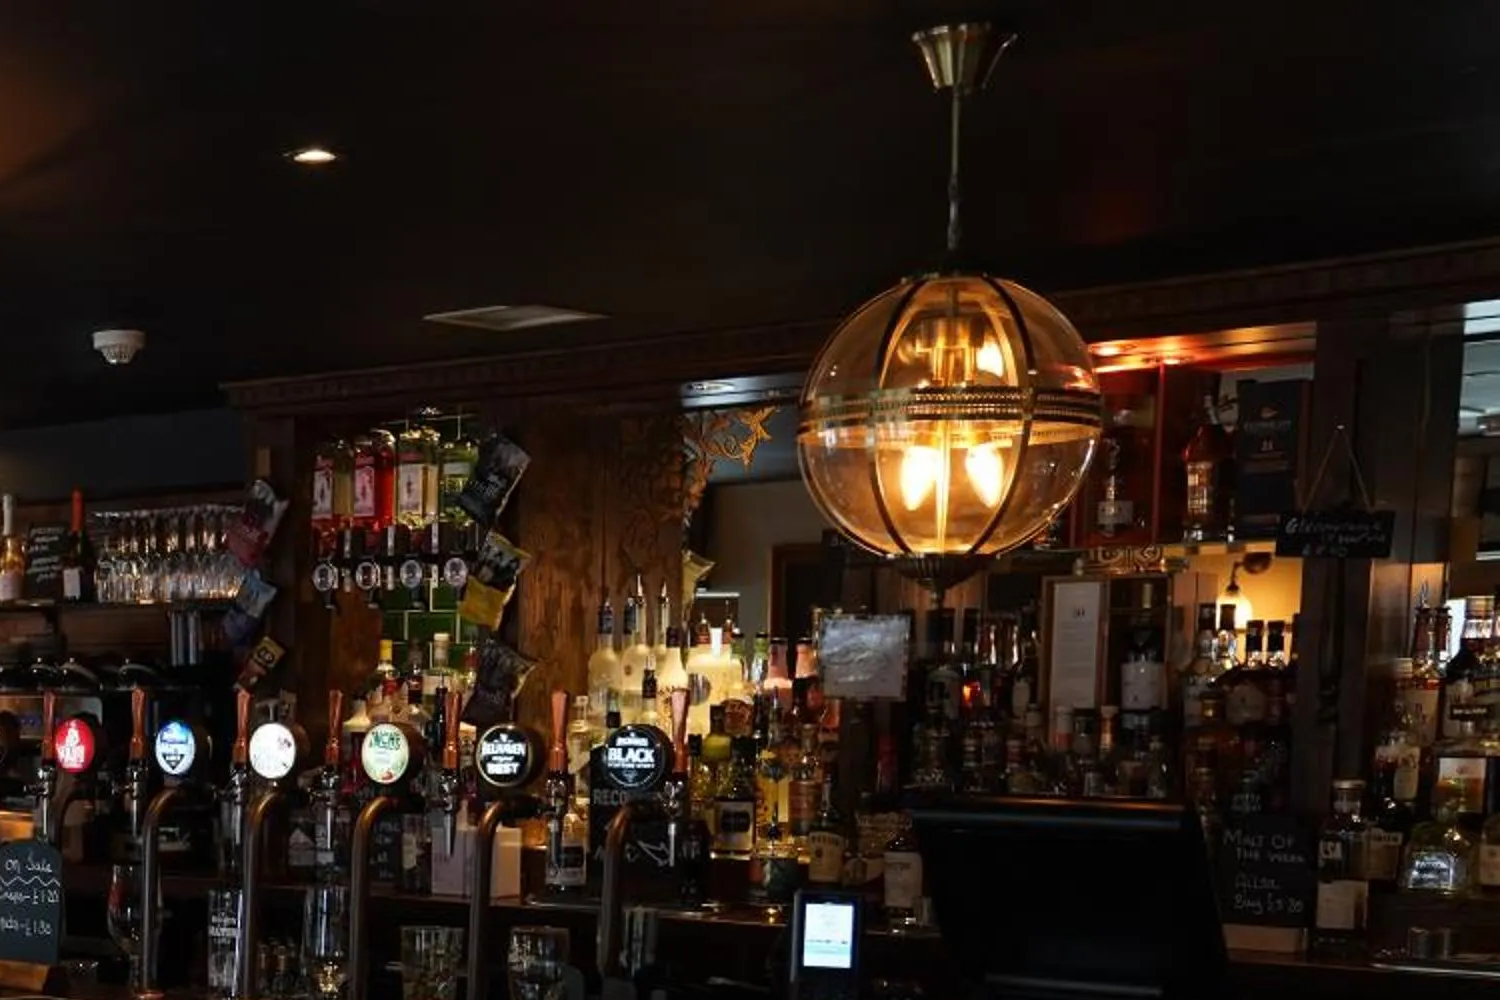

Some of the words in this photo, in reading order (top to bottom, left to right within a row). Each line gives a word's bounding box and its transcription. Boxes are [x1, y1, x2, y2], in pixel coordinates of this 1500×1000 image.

[481, 741, 527, 756] BELHAVEN
[607, 747, 655, 763] BLACK
[485, 763, 520, 775] BEST
